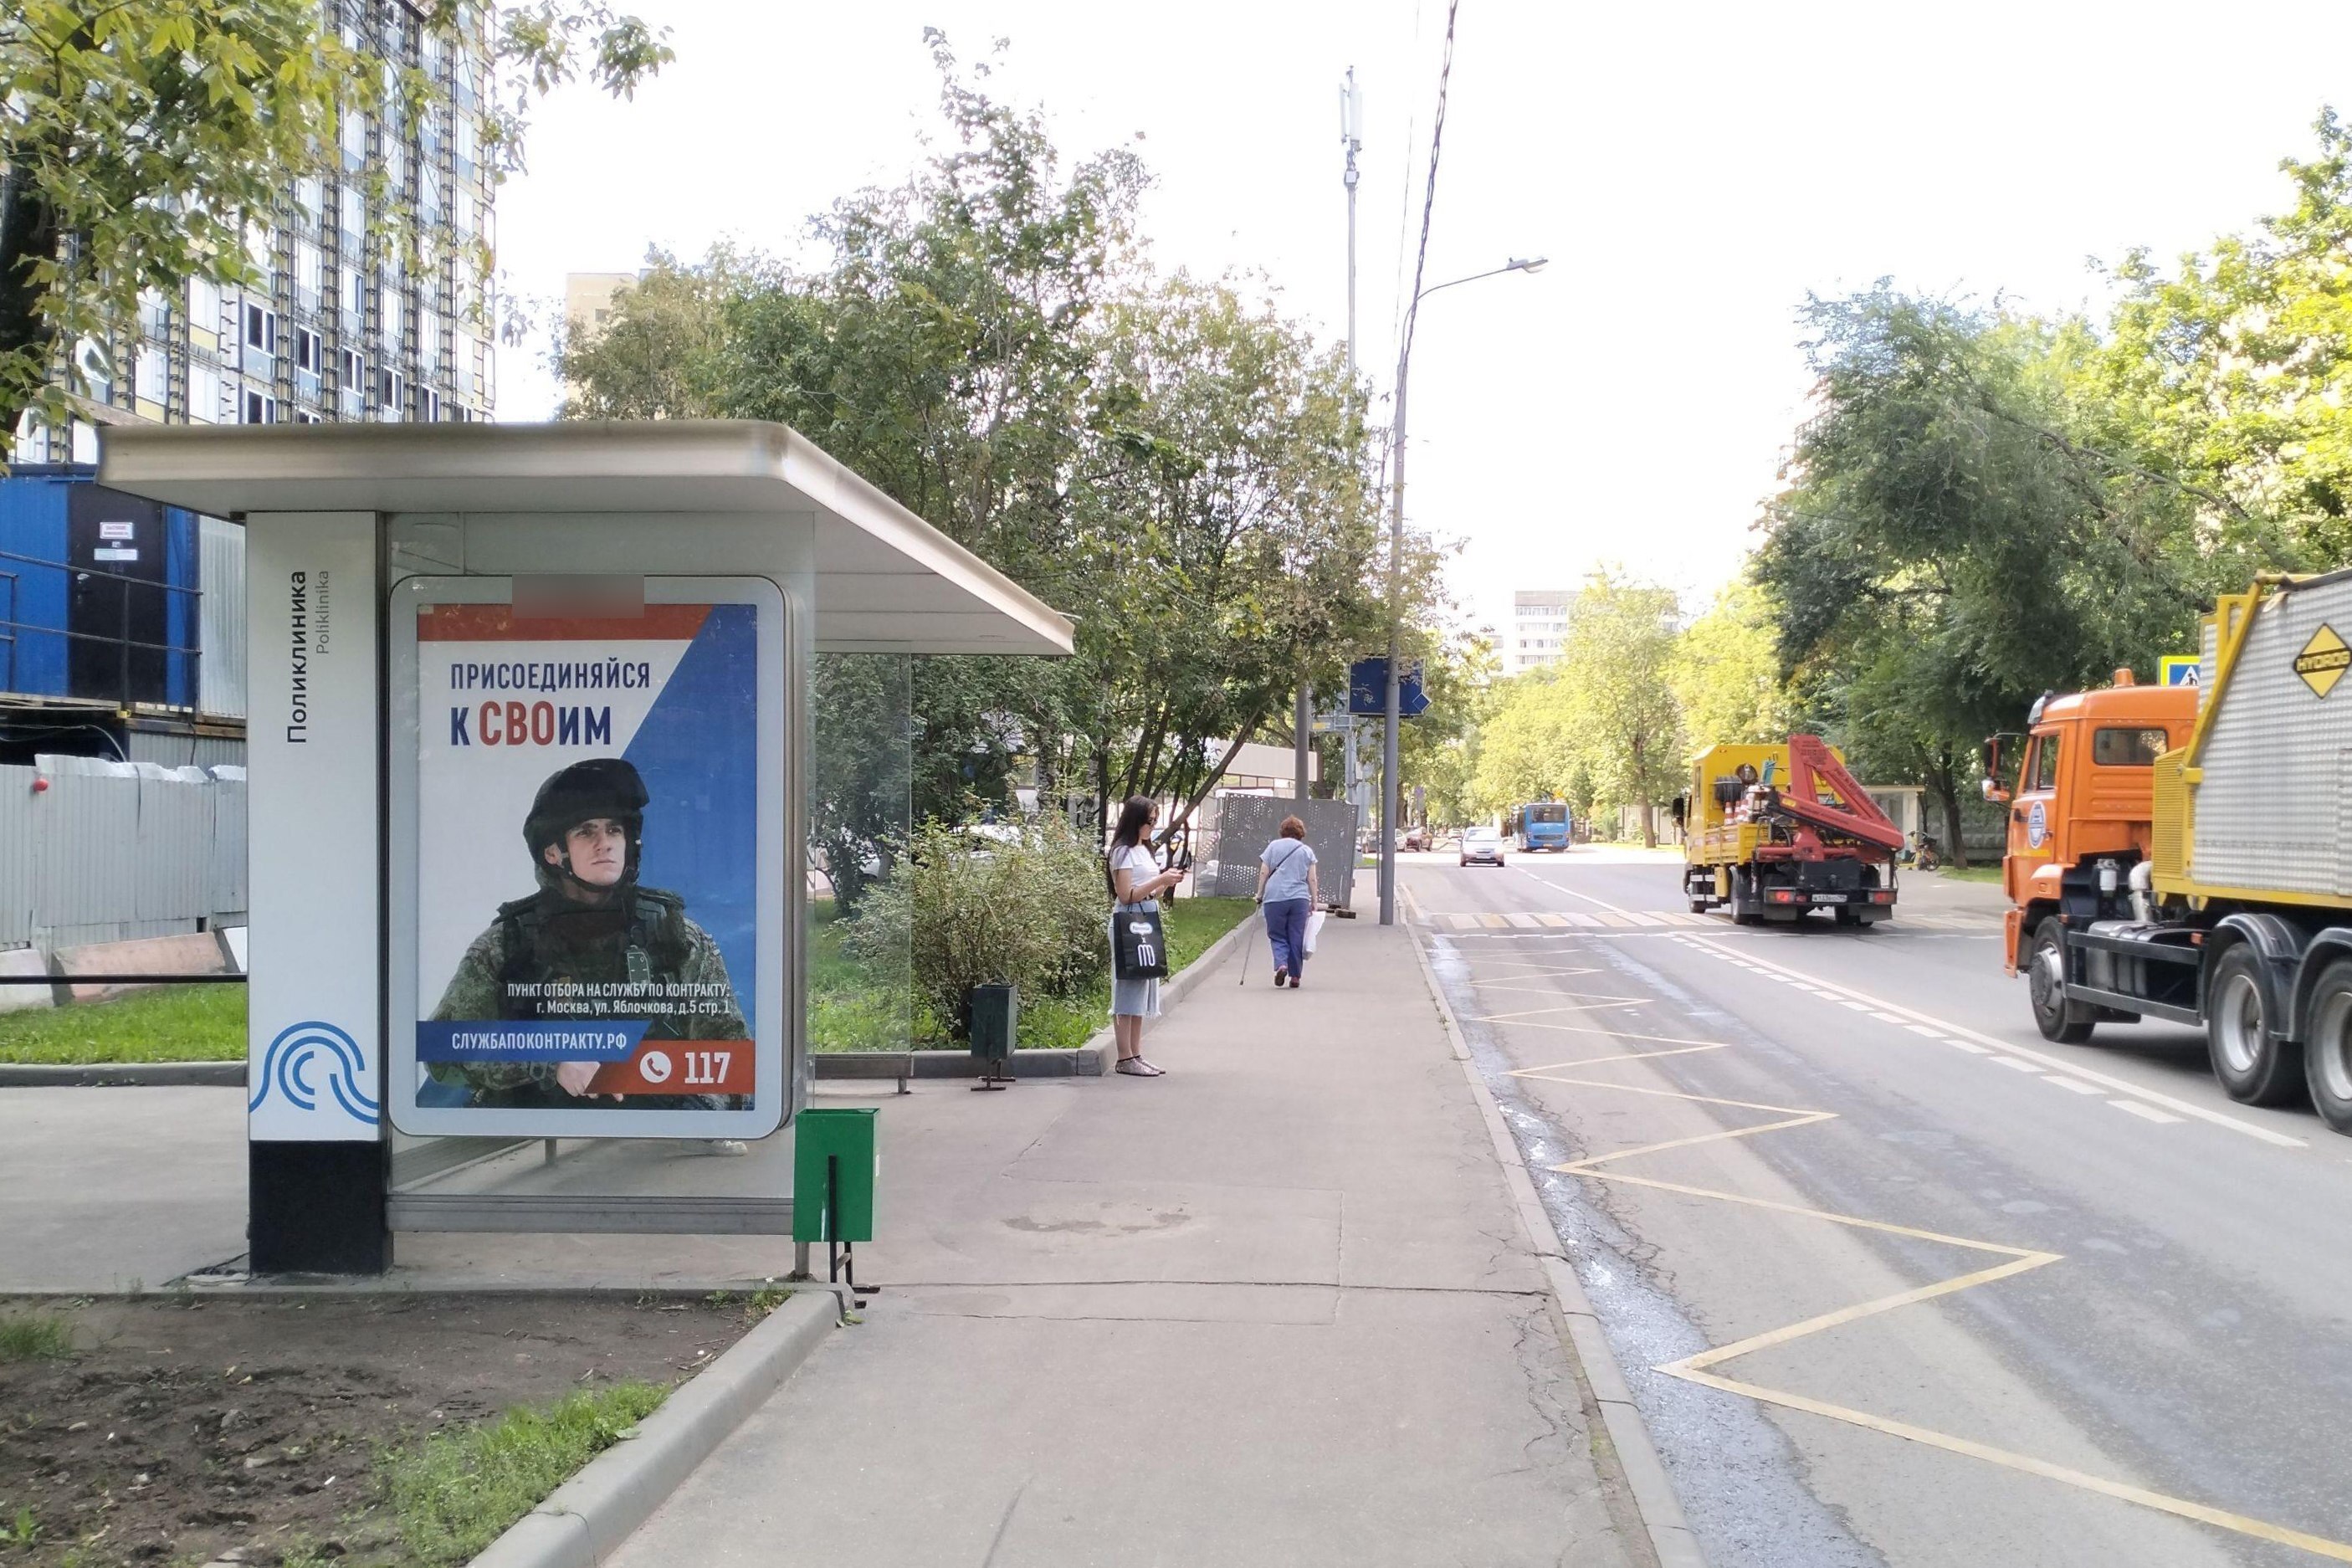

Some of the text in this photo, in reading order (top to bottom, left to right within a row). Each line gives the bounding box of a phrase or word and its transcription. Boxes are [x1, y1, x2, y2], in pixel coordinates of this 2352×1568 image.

[315, 571, 329, 654] Poliklinika
[287, 571, 307, 743] Поликлиника
[451, 657, 650, 692] ПРИСОЕДИНЯЙСЯ
[451, 707, 470, 746] К
[507, 983, 730, 997] ПУНКТ ОТБОРА НА СЛУЖБУ ПО КОНТРАКТУ:
[536, 1000, 730, 1016] г. Москва, ул. Яблочкова, д.5 стр. 1
[452, 1033, 627, 1050] СЛУЖБАПОКОНТРАКТУ.РФ
[684, 1052, 730, 1084] 117
